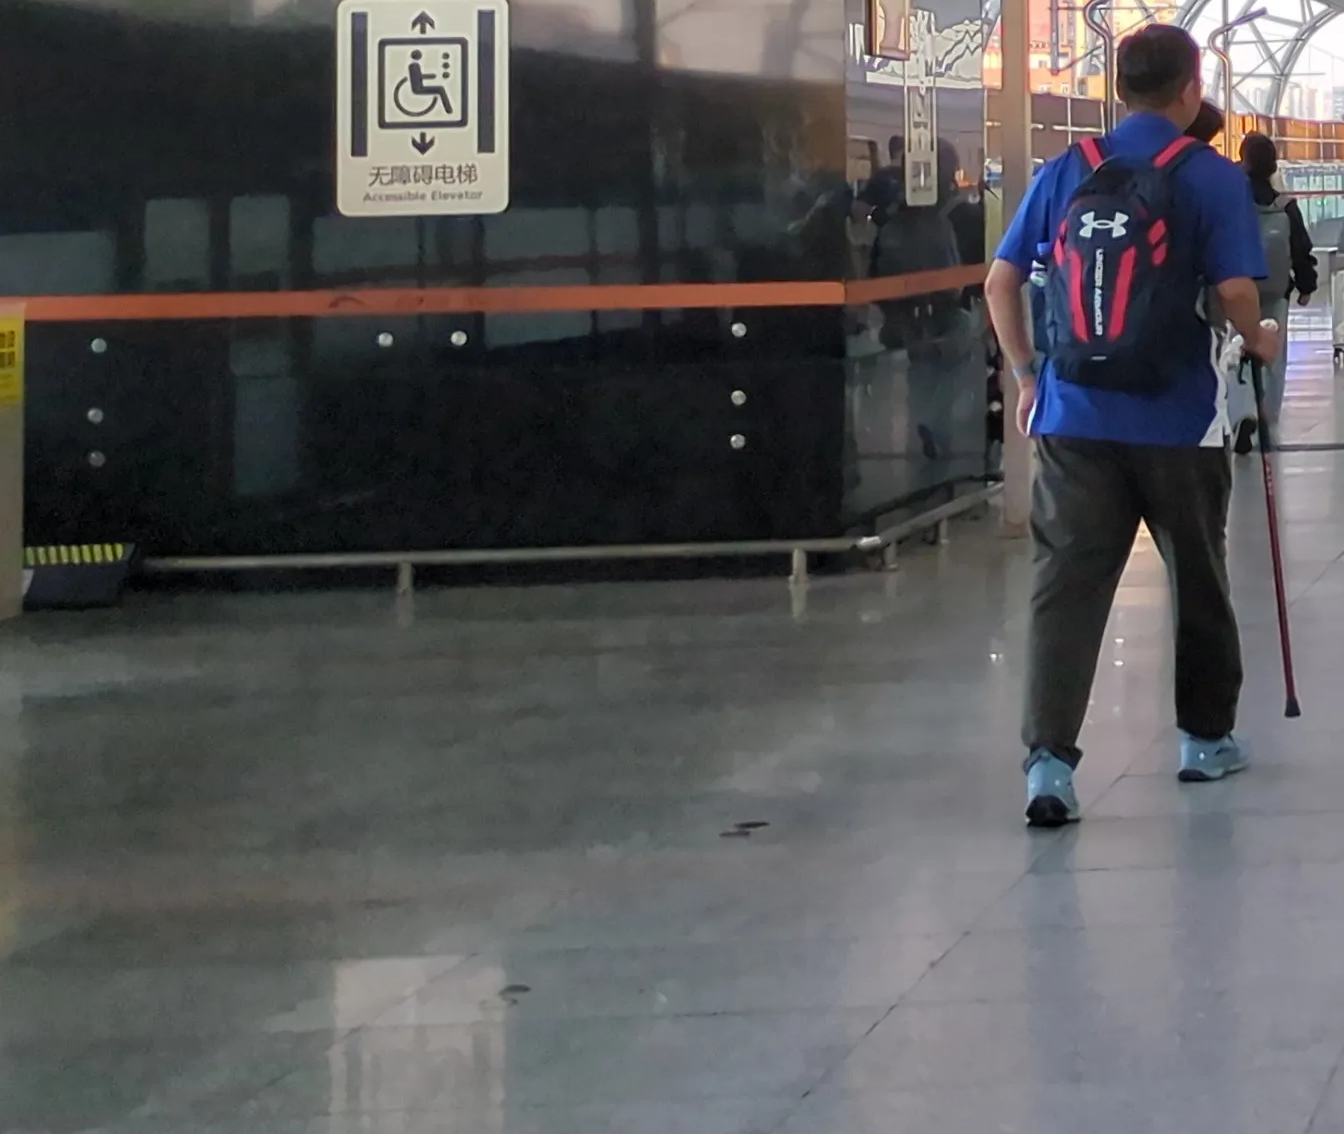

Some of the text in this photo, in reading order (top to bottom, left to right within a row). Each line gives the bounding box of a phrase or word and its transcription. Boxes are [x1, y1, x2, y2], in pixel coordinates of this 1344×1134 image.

[368, 163, 479, 187] 无障碍电梯
[362, 190, 483, 203] Accessible Elevator
